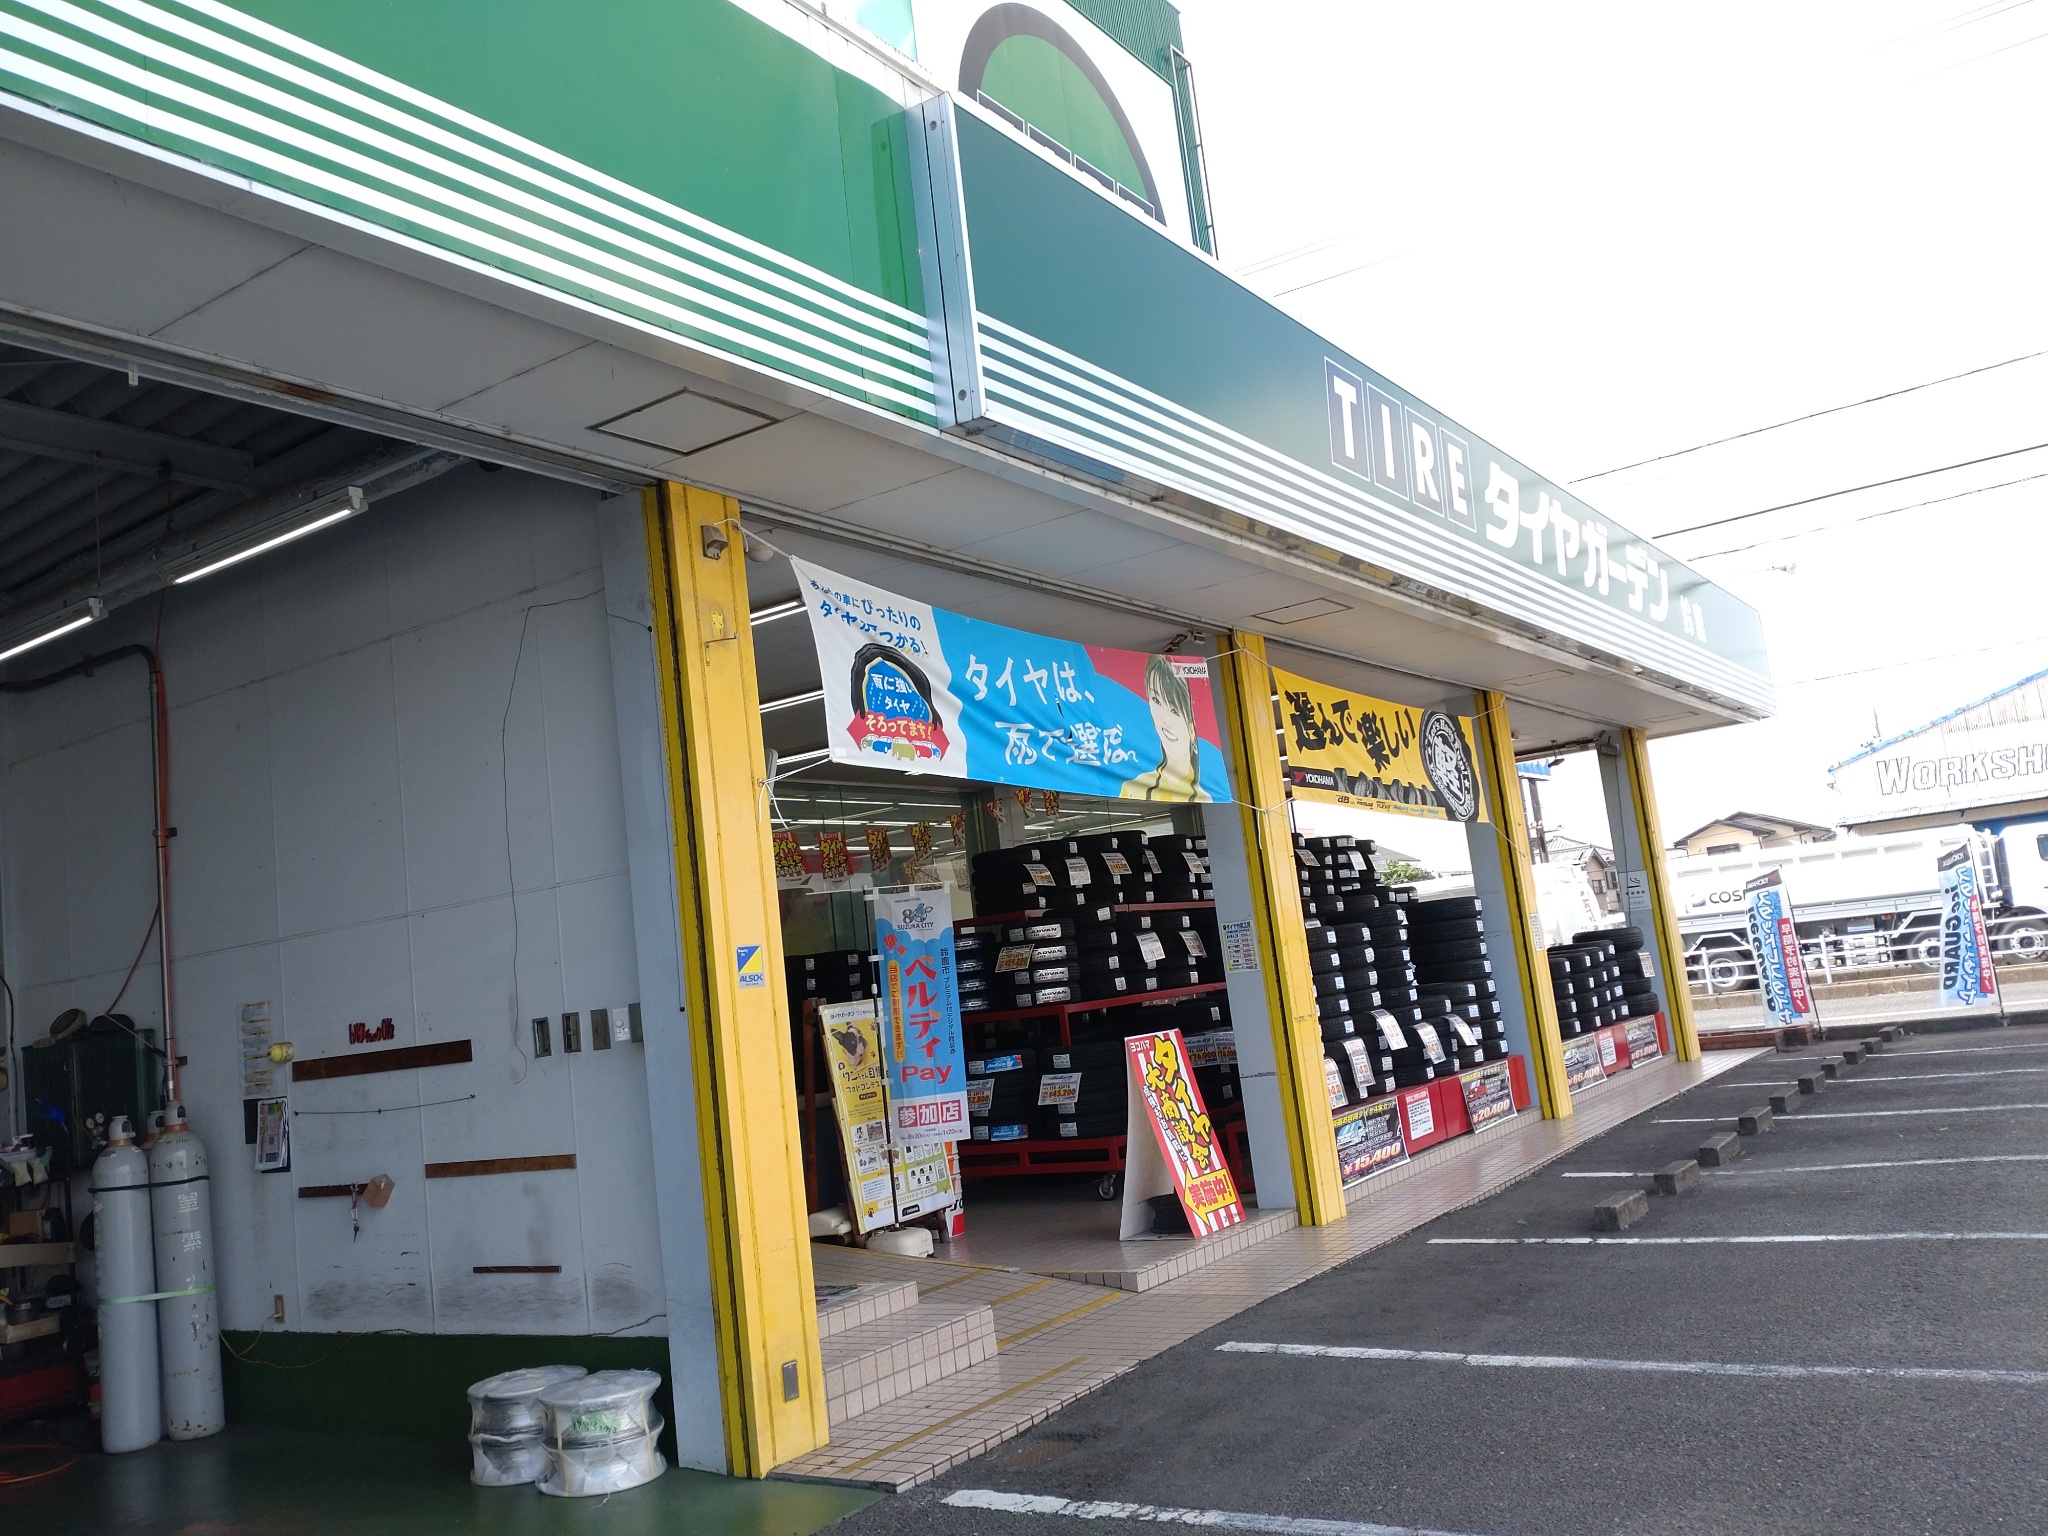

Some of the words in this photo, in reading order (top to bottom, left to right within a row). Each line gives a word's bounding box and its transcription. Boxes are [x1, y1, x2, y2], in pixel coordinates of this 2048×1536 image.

[1333, 375, 1468, 514] TIRE
[1485, 460, 1669, 622] タイヤガーデン
[871, 673, 914, 694] 雨に強い
[965, 654, 1094, 707] タイヤは、
[885, 696, 910, 714] タイヤ
[866, 715, 931, 740] そろってます!
[1285, 690, 1416, 774] 選んで楽しい
[1305, 773, 1334, 786] YOKOHAMA
[1876, 743, 2048, 796] WORKSH
[1709, 890, 1746, 904] COS
[740, 974, 763, 983] ALSOK
[904, 955, 941, 1058] ベルディ
[1130, 1039, 1150, 1052] ヨコハマ
[902, 1065, 953, 1085] Pay
[1154, 1036, 1212, 1144] タイヤ
[899, 1101, 961, 1127] 参加店
[1146, 1063, 1211, 1170] 大商談会
[1472, 1100, 1510, 1122] ¥20,400
[1343, 1142, 1401, 1175] ¥15,400
